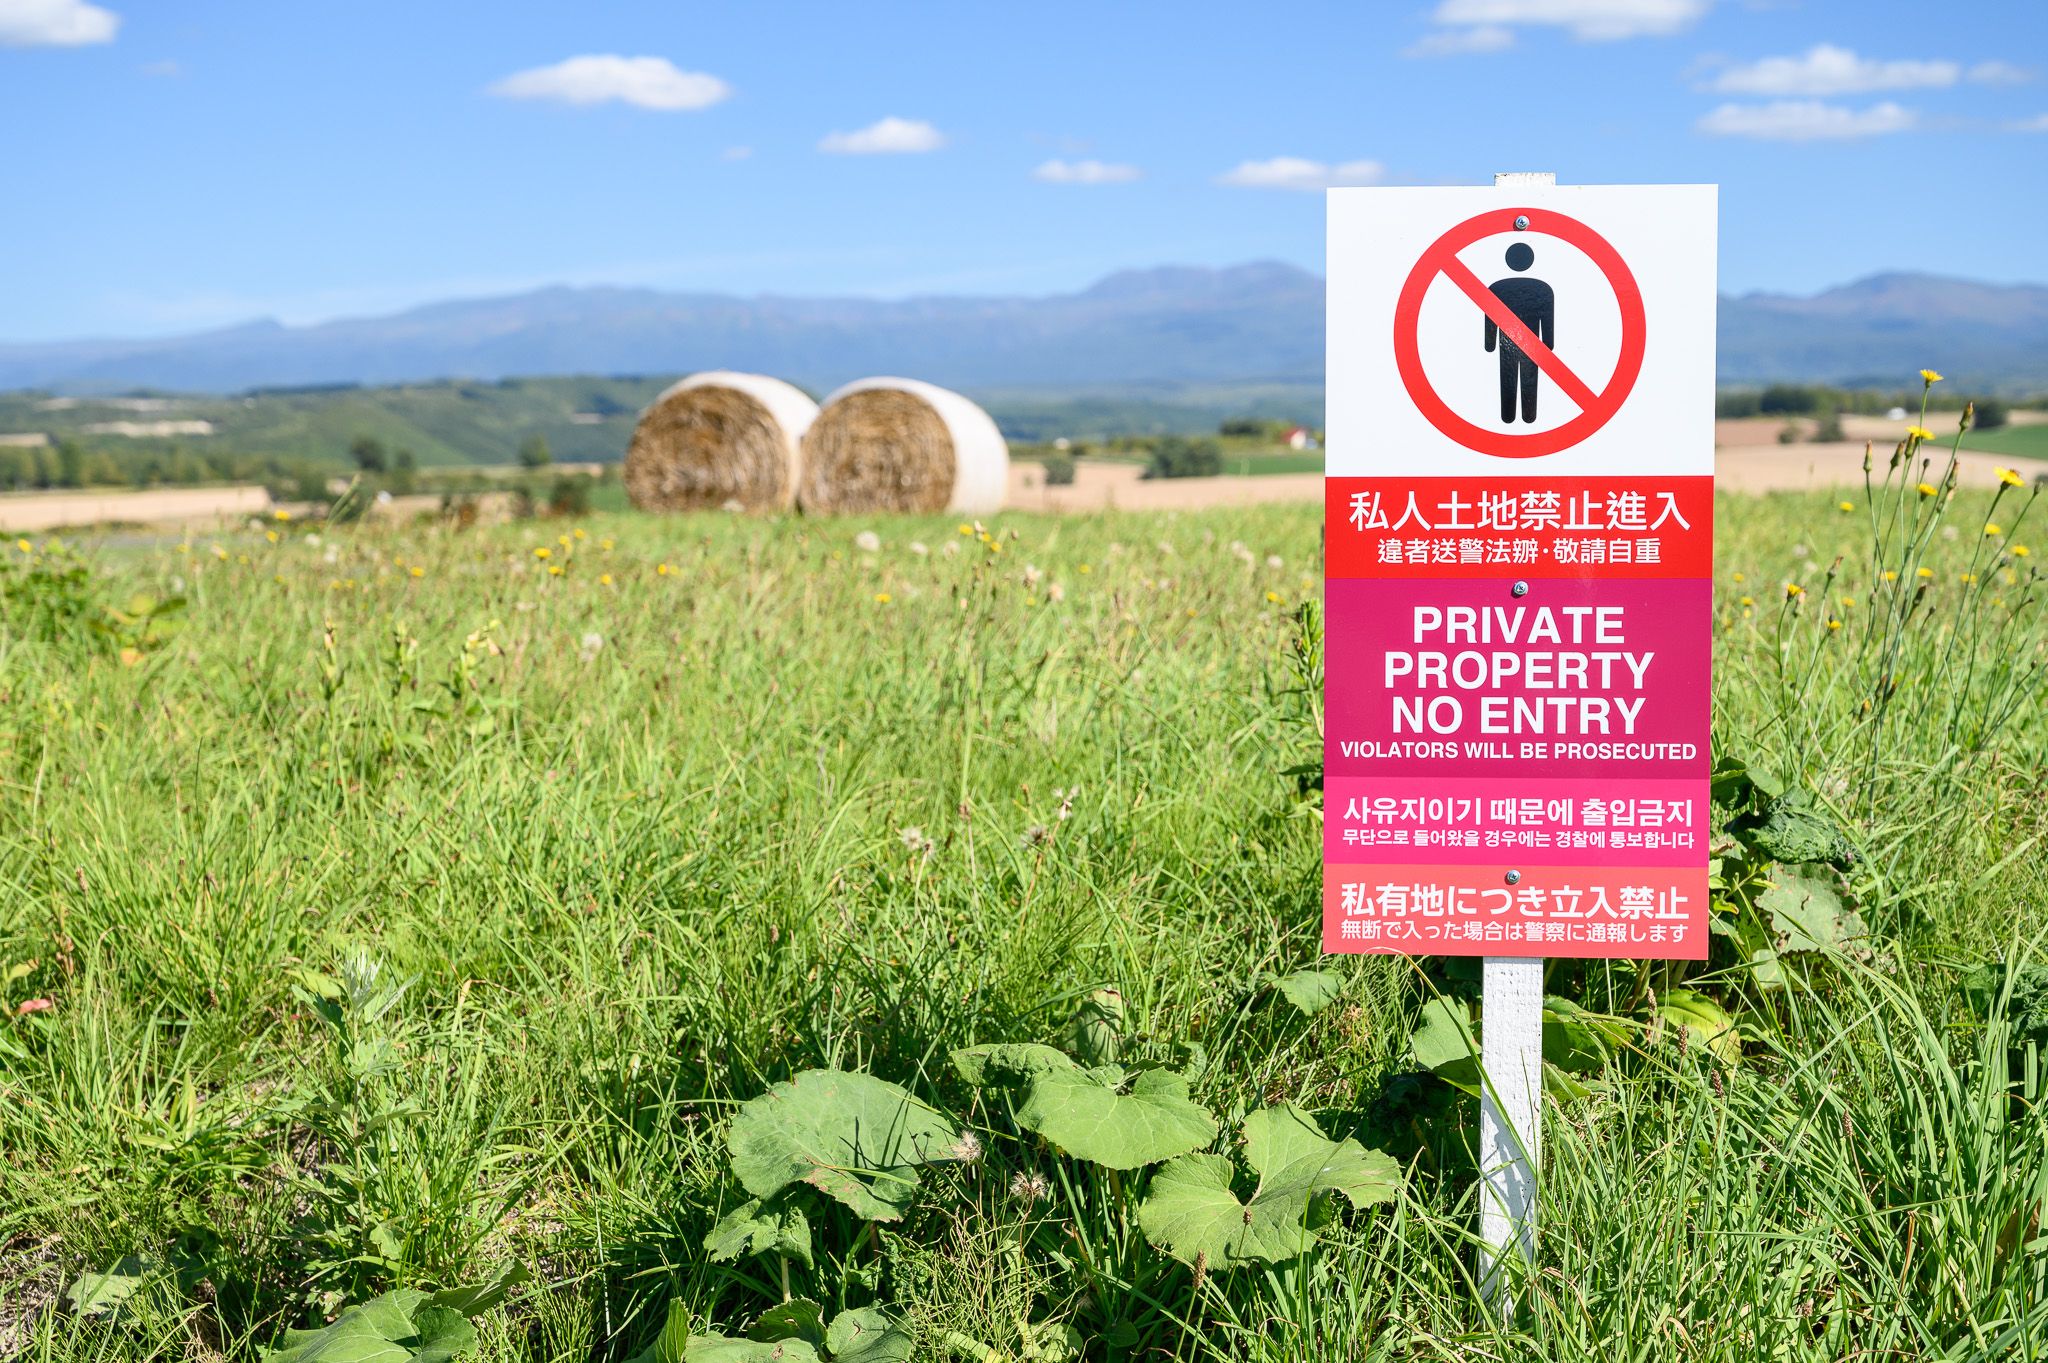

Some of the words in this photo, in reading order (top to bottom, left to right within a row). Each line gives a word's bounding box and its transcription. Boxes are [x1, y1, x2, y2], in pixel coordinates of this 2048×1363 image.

[1350, 491, 1690, 531] 私人土地禁止進入
[1414, 607, 1624, 643] PRIVATE
[1386, 651, 1654, 689] PROPERTY
[1393, 696, 1462, 734] NO
[1481, 697, 1646, 734] ENTRY
[1341, 741, 1458, 758] VIOLATORS
[1464, 743, 1513, 758] WILL
[1521, 743, 1547, 758] BE
[1555, 743, 1696, 759] PROSECUTED
[1344, 797, 1481, 825] 사유지이기
[1491, 798, 1572, 825] 때문에
[1581, 799, 1691, 826] 출입금지
[1343, 829, 1409, 845] 무단으로
[1413, 830, 1480, 846] 들어왔을
[1485, 830, 1551, 847] 경우에는
[1556, 831, 1605, 848] 경찰에
[1610, 832, 1694, 848] 통보합니다
[1341, 883, 1689, 920] 私有地につき立入禁止
[1341, 920, 1689, 943] 無断で入った場合は警察に通報します
